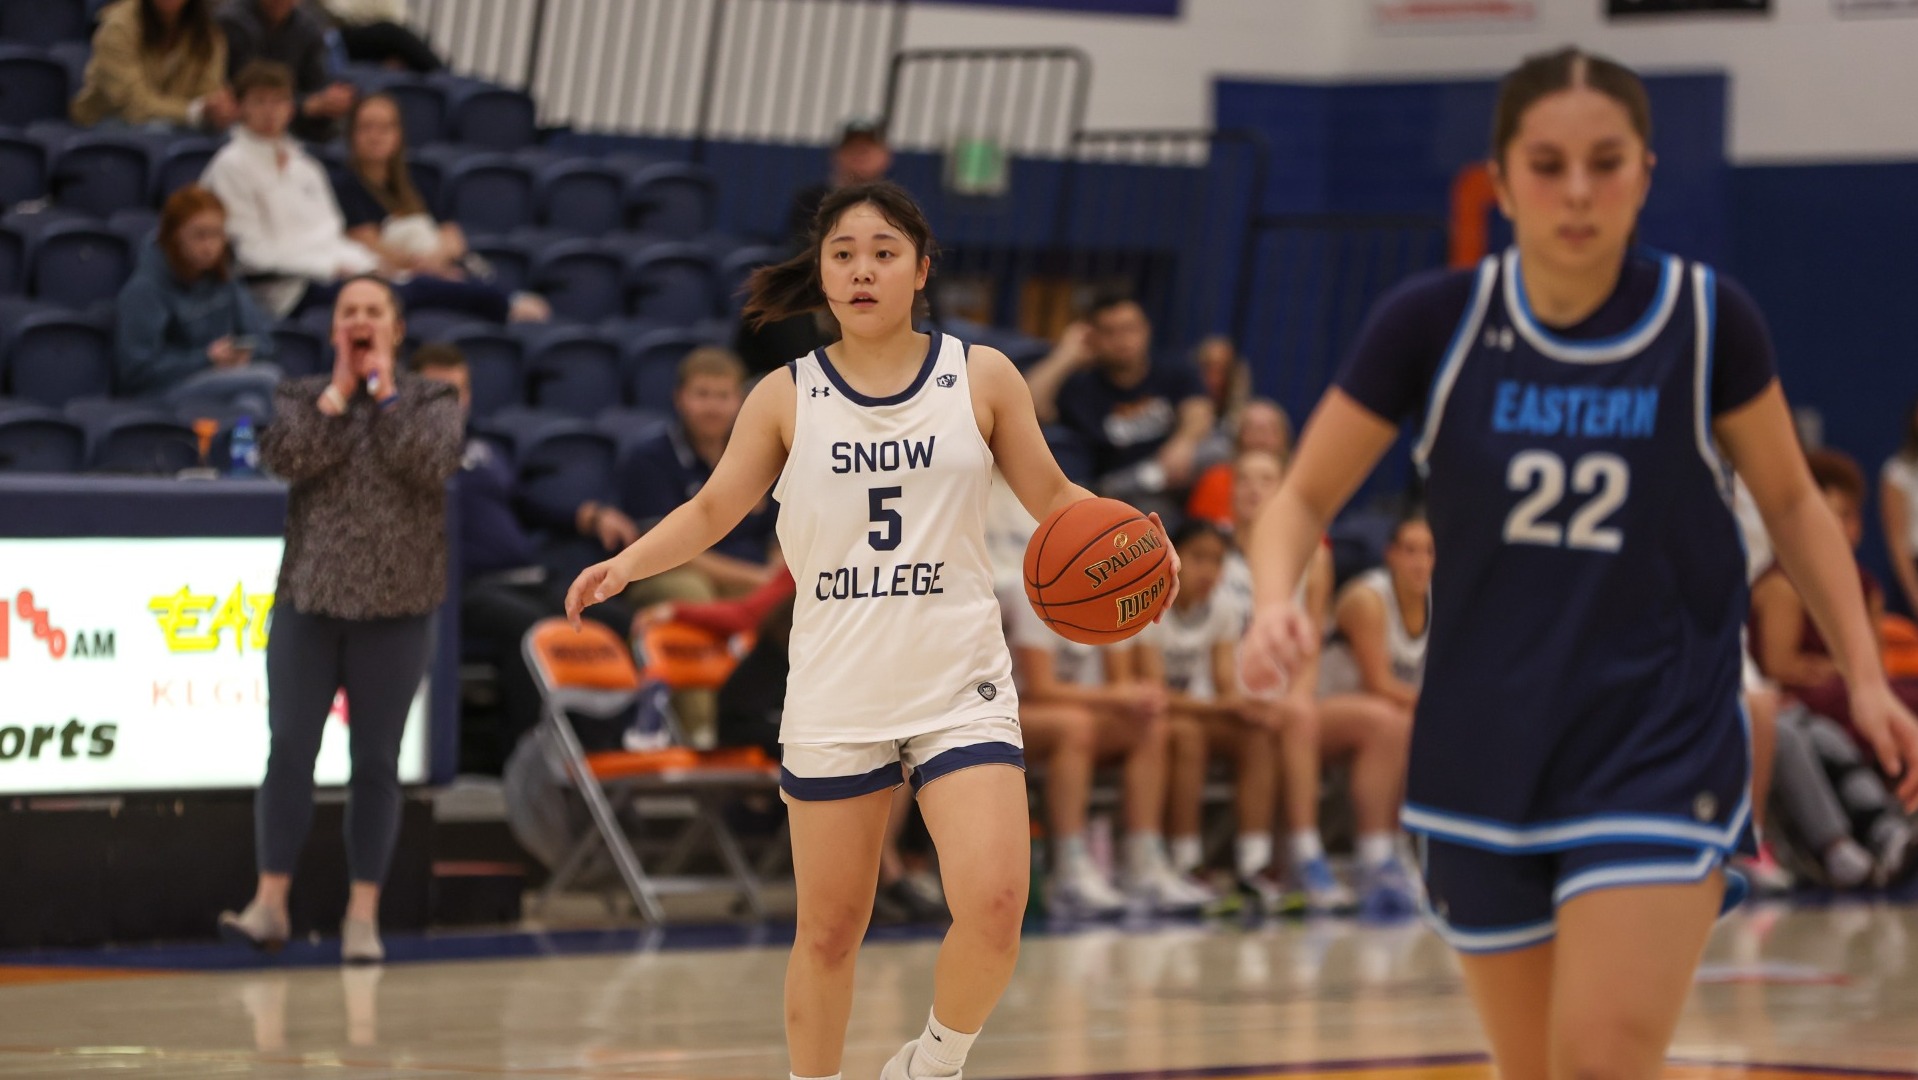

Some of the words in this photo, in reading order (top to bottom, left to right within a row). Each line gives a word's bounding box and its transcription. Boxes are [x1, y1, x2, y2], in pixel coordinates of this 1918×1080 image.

[1492, 378, 1659, 438] EASTERN
[832, 435, 936, 474] SNOW
[868, 485, 903, 552] 5
[1502, 448, 1630, 552] 22
[815, 561, 945, 602] COLLEGE
[1084, 528, 1163, 591] SPALDING
[72, 630, 116, 658] AM
[0, 718, 117, 760] orts
